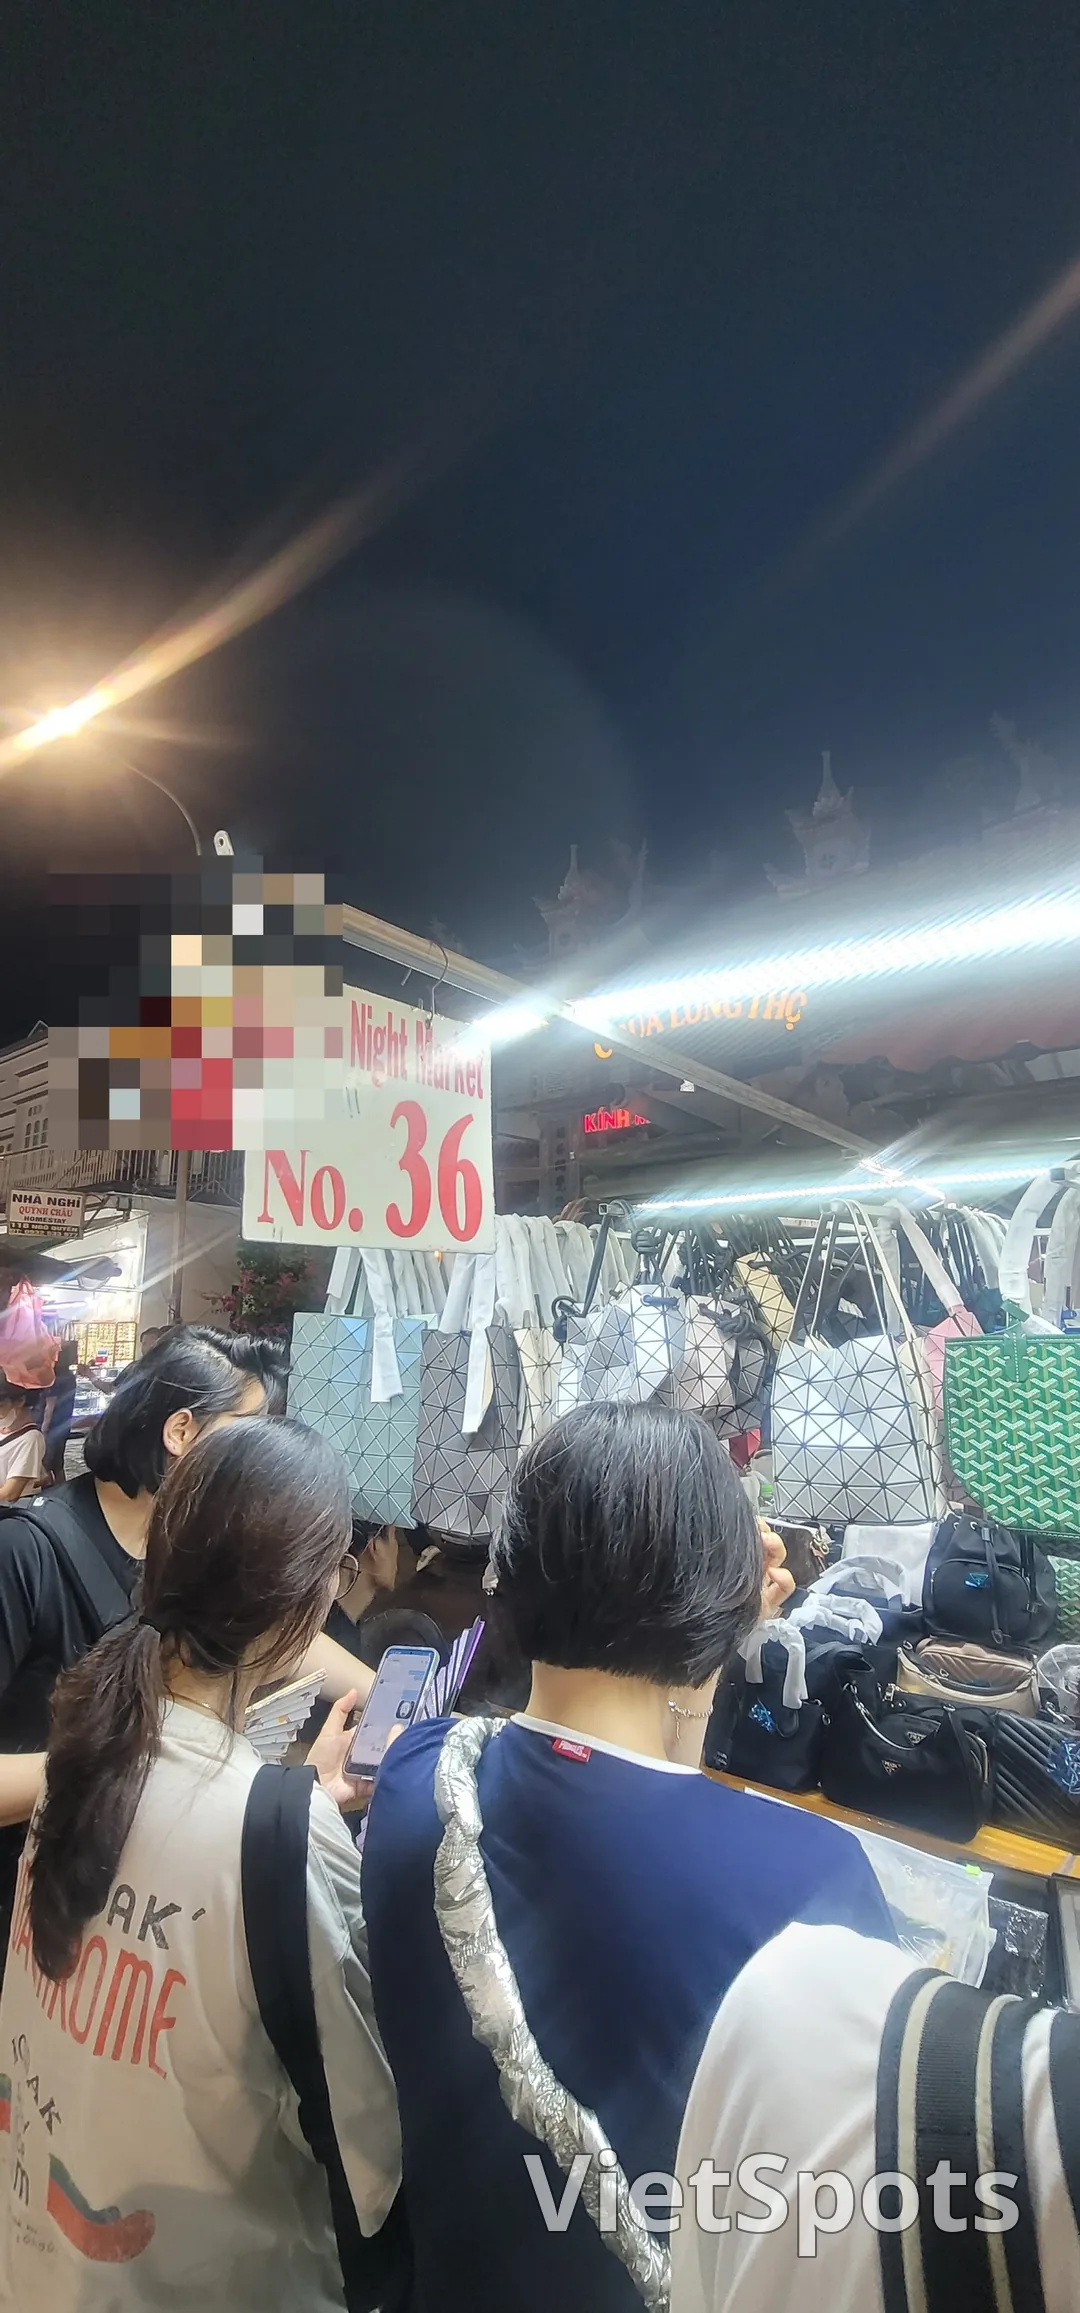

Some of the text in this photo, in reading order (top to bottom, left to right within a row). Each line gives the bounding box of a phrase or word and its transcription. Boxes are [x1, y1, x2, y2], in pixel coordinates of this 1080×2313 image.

[350, 1000, 408, 1088] Night
[584, 1106, 630, 1133] KÍNH
[257, 1149, 363, 1232] No.
[385, 1100, 483, 1242] 36
[24, 1215, 67, 1224] HOMESTAY
